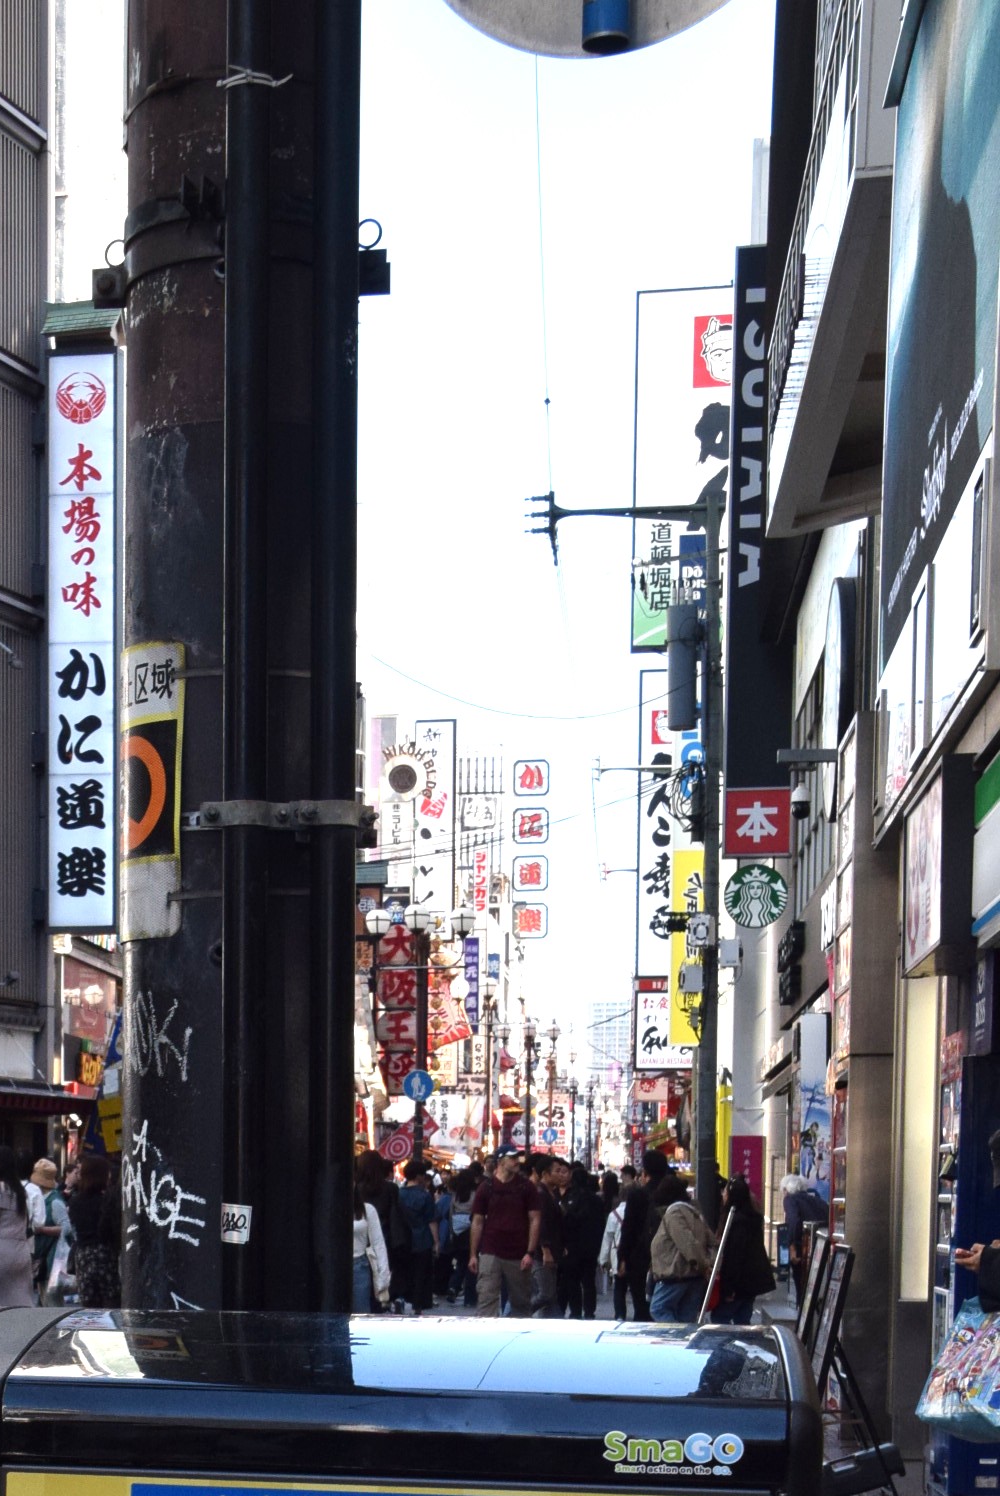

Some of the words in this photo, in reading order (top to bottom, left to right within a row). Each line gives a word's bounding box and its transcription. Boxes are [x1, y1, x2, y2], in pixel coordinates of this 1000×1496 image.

[58, 442, 102, 618] 本場の味
[650, 522, 672, 612] 道頓堀店
[382, 743, 426, 762] NIKOH
[736, 801, 778, 843] 本
[475, 851, 486, 912] ジャンカラ
[667, 1057, 693, 1065] RESTAURA
[602, 1430, 744, 1465] SmaGO
[614, 1463, 646, 1473] Smart
[647, 1464, 678, 1475] action
[679, 1467, 693, 1475] on
[694, 1465, 711, 1475] the
